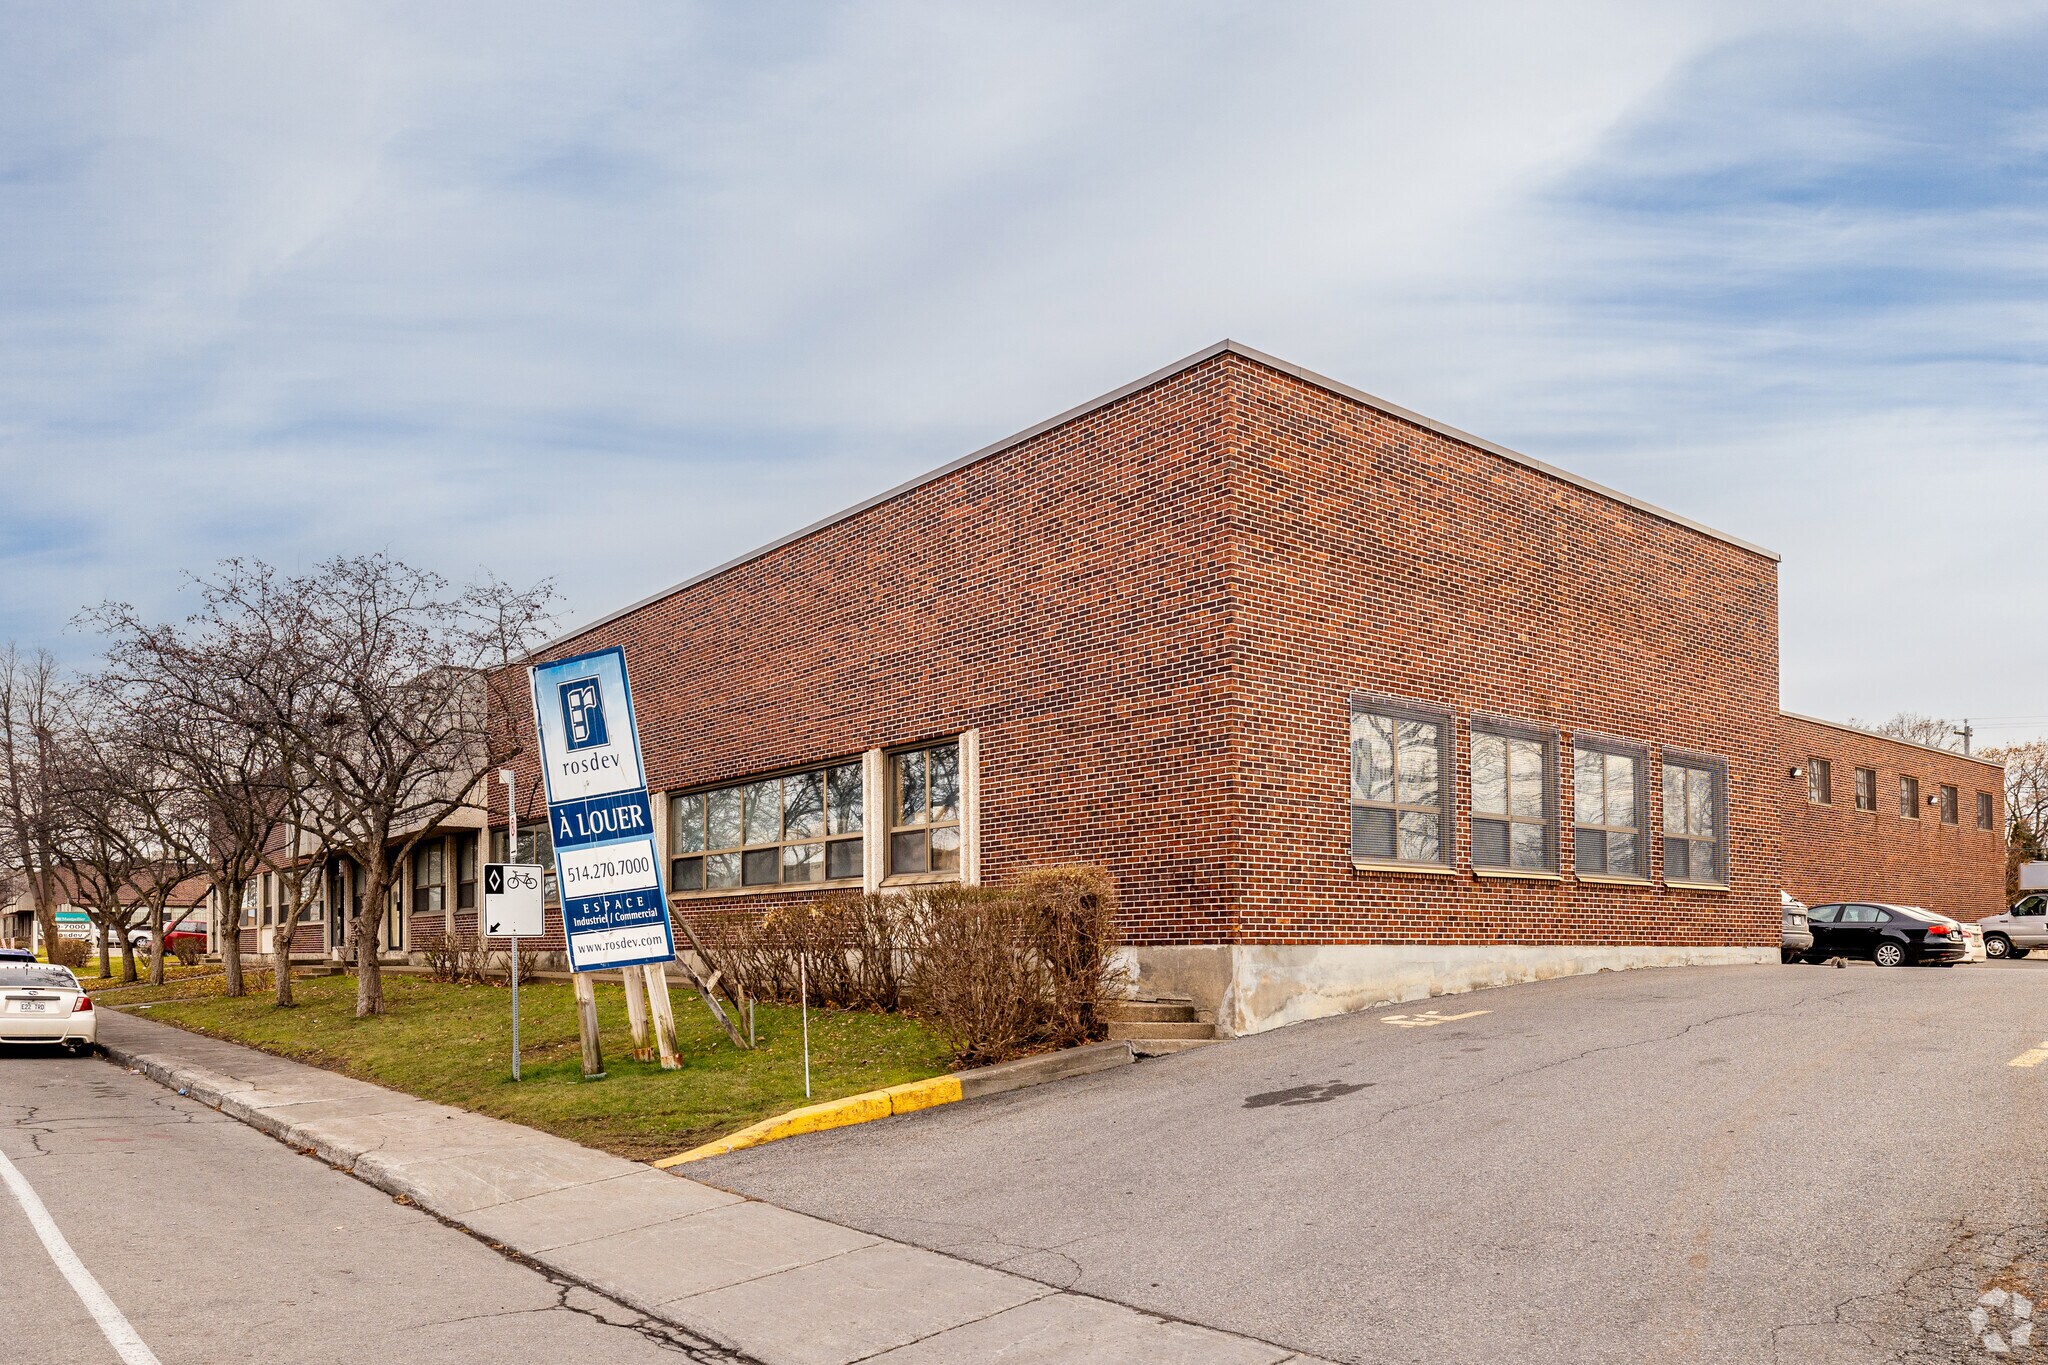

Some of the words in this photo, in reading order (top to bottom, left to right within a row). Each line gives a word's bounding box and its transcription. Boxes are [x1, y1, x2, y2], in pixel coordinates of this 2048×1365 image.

[562, 752, 620, 776] rosdev
[559, 808, 574, 840] À
[576, 804, 645, 836] LOUER
[567, 856, 650, 883] 514.270.7000
[573, 914, 608, 927] Industriel
[614, 907, 658, 922] Commercial
[577, 935, 663, 954] www.rosdev.com
